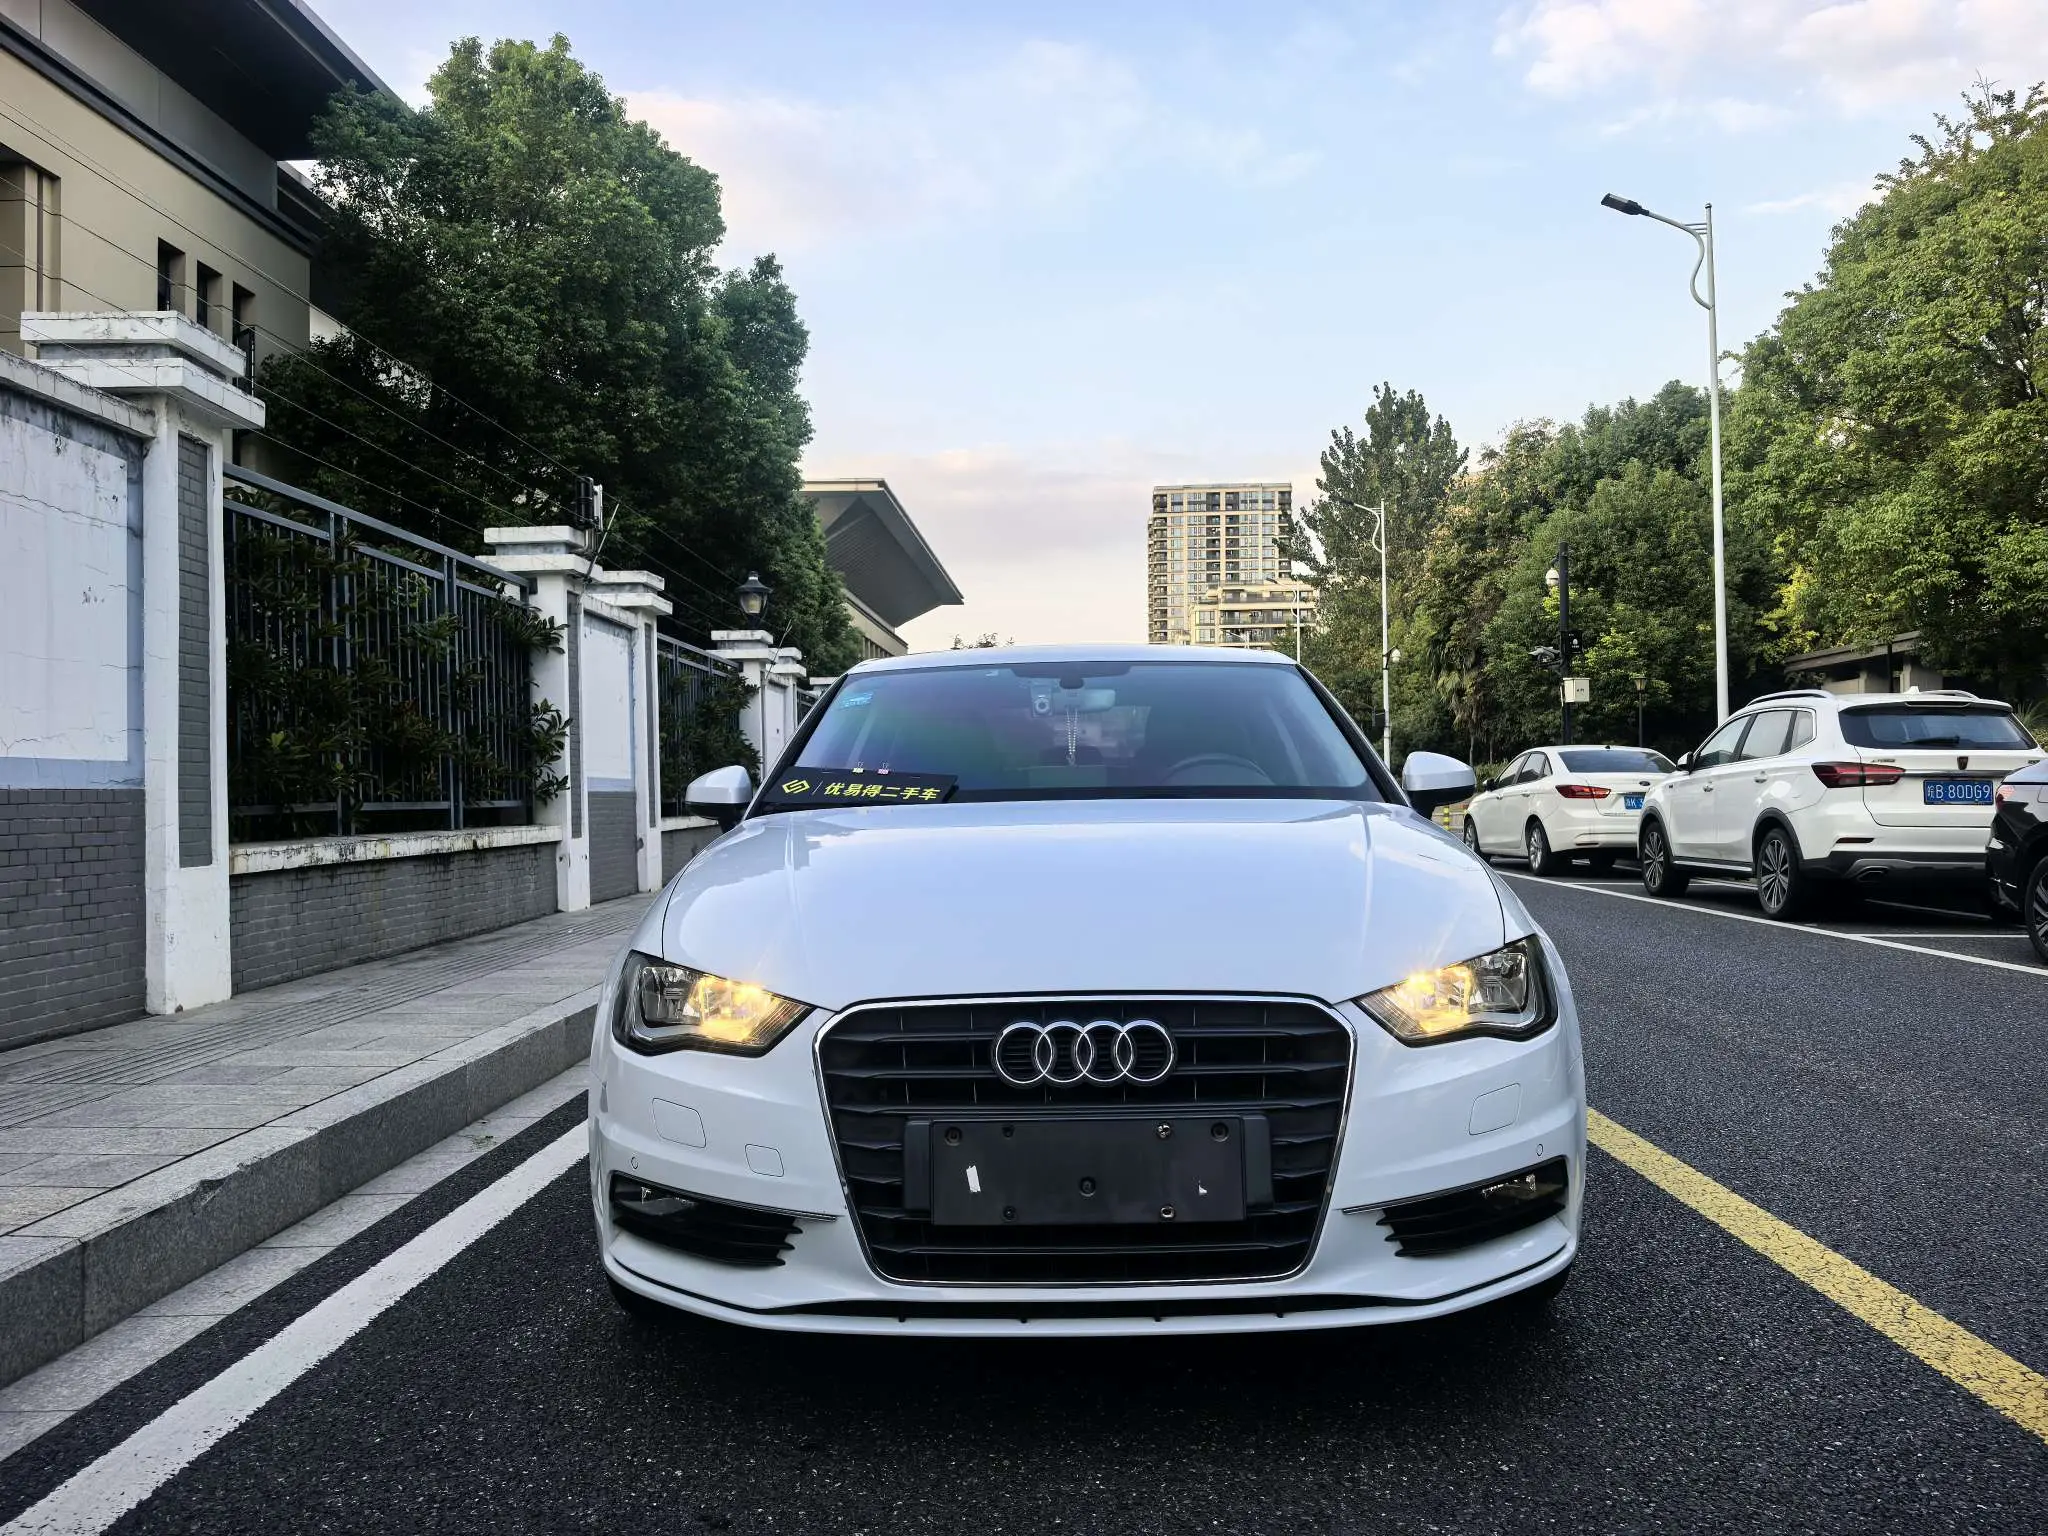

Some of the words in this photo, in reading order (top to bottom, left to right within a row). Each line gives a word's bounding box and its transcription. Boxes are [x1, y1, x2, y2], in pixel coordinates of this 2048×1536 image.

[824, 782, 941, 801] 优易得二手车
